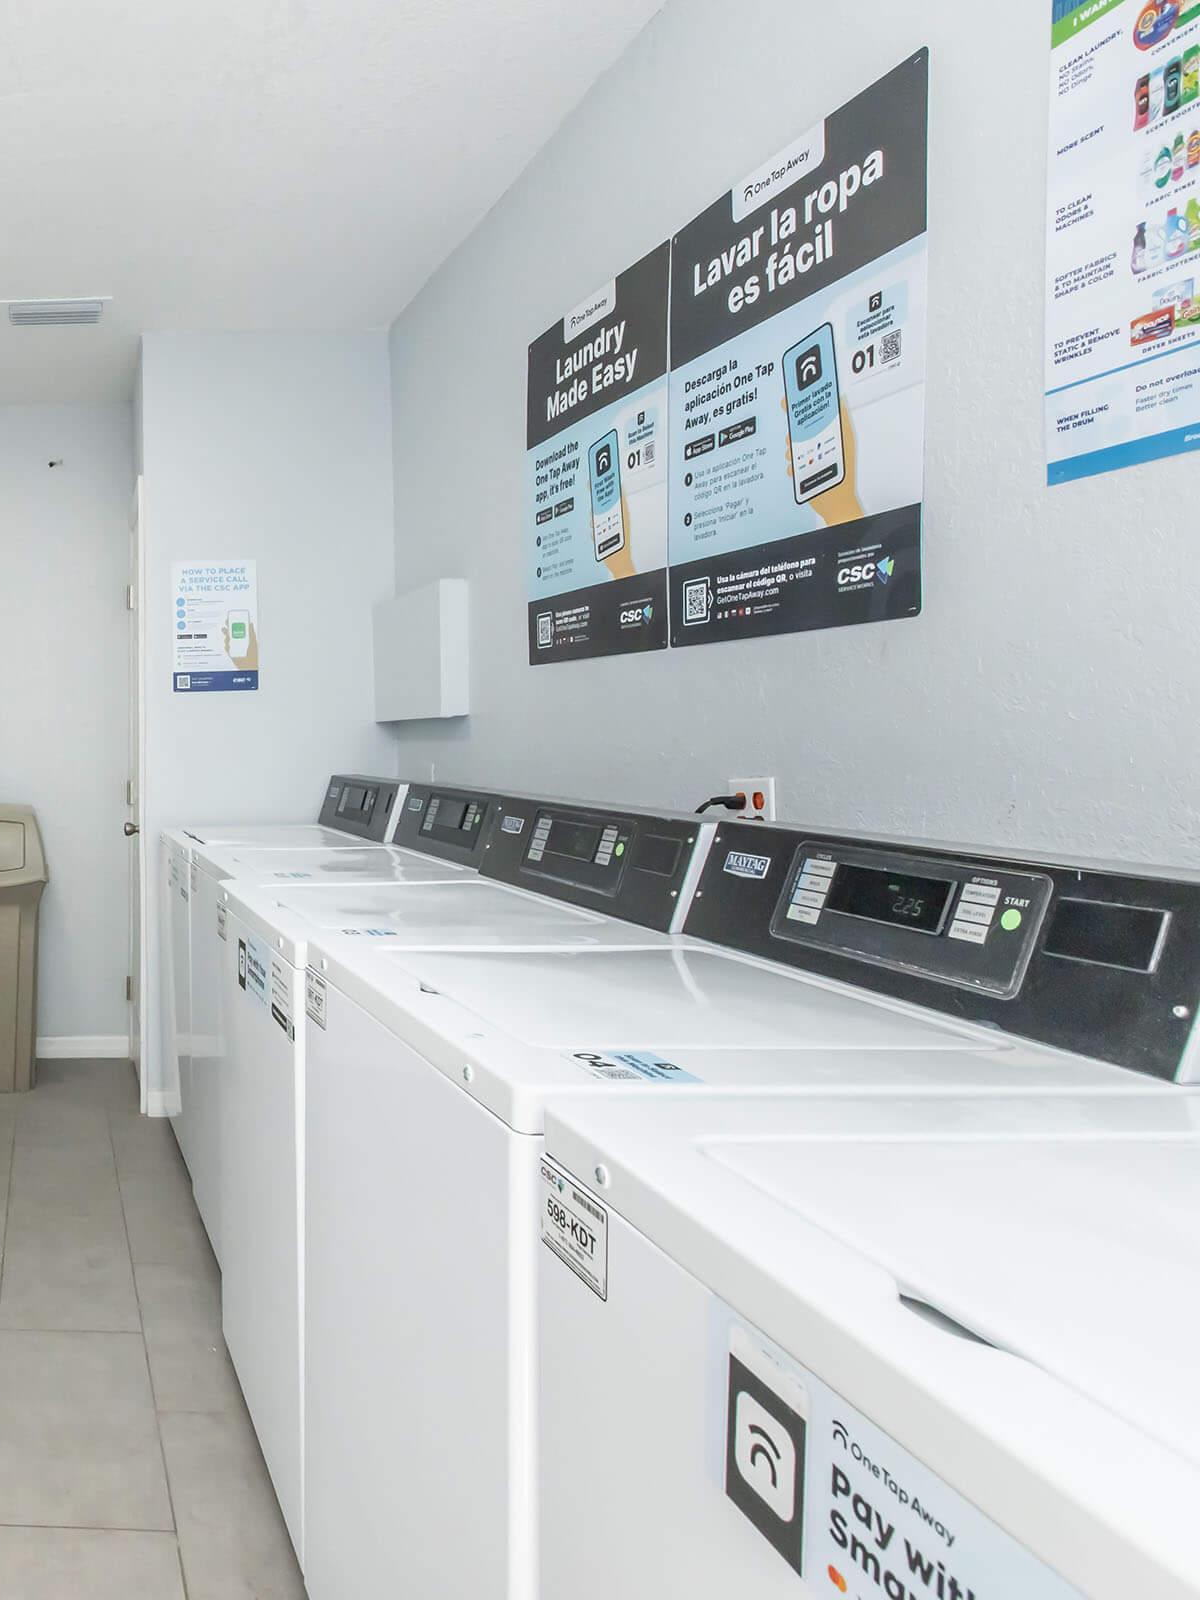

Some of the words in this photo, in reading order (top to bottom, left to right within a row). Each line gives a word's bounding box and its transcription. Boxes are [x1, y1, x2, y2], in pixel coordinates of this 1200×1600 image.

[1059, 54, 1083, 73] CLEAN
[1080, 125, 1105, 143] SCENT
[754, 177, 771, 194] One
[771, 166, 786, 183] Tap
[786, 149, 810, 173] Away
[1056, 207, 1066, 216] TO
[1067, 194, 1093, 211] CLEAN
[1144, 191, 1172, 208] FABRIC
[1174, 180, 1196, 194] RINSE
[693, 225, 764, 297] Lavar
[770, 206, 797, 246] la
[804, 150, 883, 224] ropa
[1055, 210, 1095, 233] MACHINES
[727, 275, 760, 313] es
[765, 218, 833, 292] fácil
[1055, 268, 1083, 284] SOFTER
[1084, 252, 1118, 271] FABRICS
[1061, 279, 1073, 288] TO
[1073, 263, 1112, 283] MAINTAIN
[1137, 267, 1165, 284] FABRIC
[1054, 284, 1080, 300] SHAPE
[1088, 270, 1115, 286] COLOR
[882, 305, 895, 316] para
[1054, 340, 1064, 350] TO
[1065, 328, 1101, 346] PREVENT
[1054, 344, 1080, 359] STATIC
[1087, 328, 1121, 346] REMOVE
[1142, 341, 1167, 354] DRYER
[1167, 331, 1197, 346] SHEETS
[556, 320, 626, 385] Laundry
[852, 344, 875, 374] 01
[1054, 346, 1094, 365] WRINKLES
[547, 379, 588, 422] Made
[592, 348, 638, 395] Easy
[684, 364, 727, 394] Descarga
[728, 358, 738, 372] la
[684, 381, 731, 413] aplicación
[733, 371, 753, 389] One
[755, 361, 775, 380] Tap
[1135, 384, 1148, 393] Do
[1148, 377, 1164, 389] not
[792, 395, 811, 411] Primer
[812, 381, 832, 398] lavado
[794, 403, 812, 418] Gratis
[813, 395, 825, 406] con
[825, 391, 832, 399] la
[1135, 393, 1157, 406] Faster
[1158, 389, 1172, 399] dry
[1172, 382, 1194, 394] times
[1135, 400, 1157, 413] Better
[1158, 395, 1179, 406] clean
[684, 413, 712, 431] Away,
[712, 405, 724, 418] es
[724, 387, 759, 415] gratis!
[797, 400, 830, 426] aplicación!
[1057, 412, 1080, 426] WHEN
[1080, 403, 1110, 418] FILLING
[1057, 423, 1071, 433] THE
[1072, 416, 1095, 429] DRUM
[536, 443, 567, 472] Download
[566, 441, 579, 456] the
[627, 449, 641, 470] 01
[536, 474, 549, 487] One
[549, 467, 561, 482] Tap
[562, 457, 580, 474] Away
[549, 482, 559, 497] it's
[560, 474, 576, 492] free!
[182, 568, 204, 576] HOW
[206, 567, 217, 575] TO
[218, 567, 246, 575] PLACE
[227, 575, 248, 583] CALL
[716, 576, 729, 584] Usa
[729, 573, 735, 581] la
[736, 569, 759, 580] cámara
[760, 566, 770, 575] del
[771, 560, 800, 573] teléfono
[800, 557, 816, 569] para
[716, 583, 745, 594] escanear
[746, 580, 753, 588] el
[753, 576, 775, 588] código
[776, 573, 788, 583] QR,
[795, 568, 814, 580] visita
[838, 562, 876, 585] CSC
[179, 585, 193, 593] VIA
[214, 584, 231, 592] CSC
[233, 583, 250, 591] APP
[716, 586, 780, 605] GetOneTapAway.com
[620, 608, 643, 624] CSC
[728, 854, 766, 872] MAYTAG
[972, 876, 998, 886] OPTIONS
[1004, 896, 1031, 908] START
[572, 1053, 616, 1069] 04
[541, 1166, 559, 1185] CSC
[547, 1197, 597, 1255] 598-KDT
[831, 1462, 896, 1552] Pay
[903, 1537, 977, 1600] wit
[829, 1508, 917, 1600] Sma
